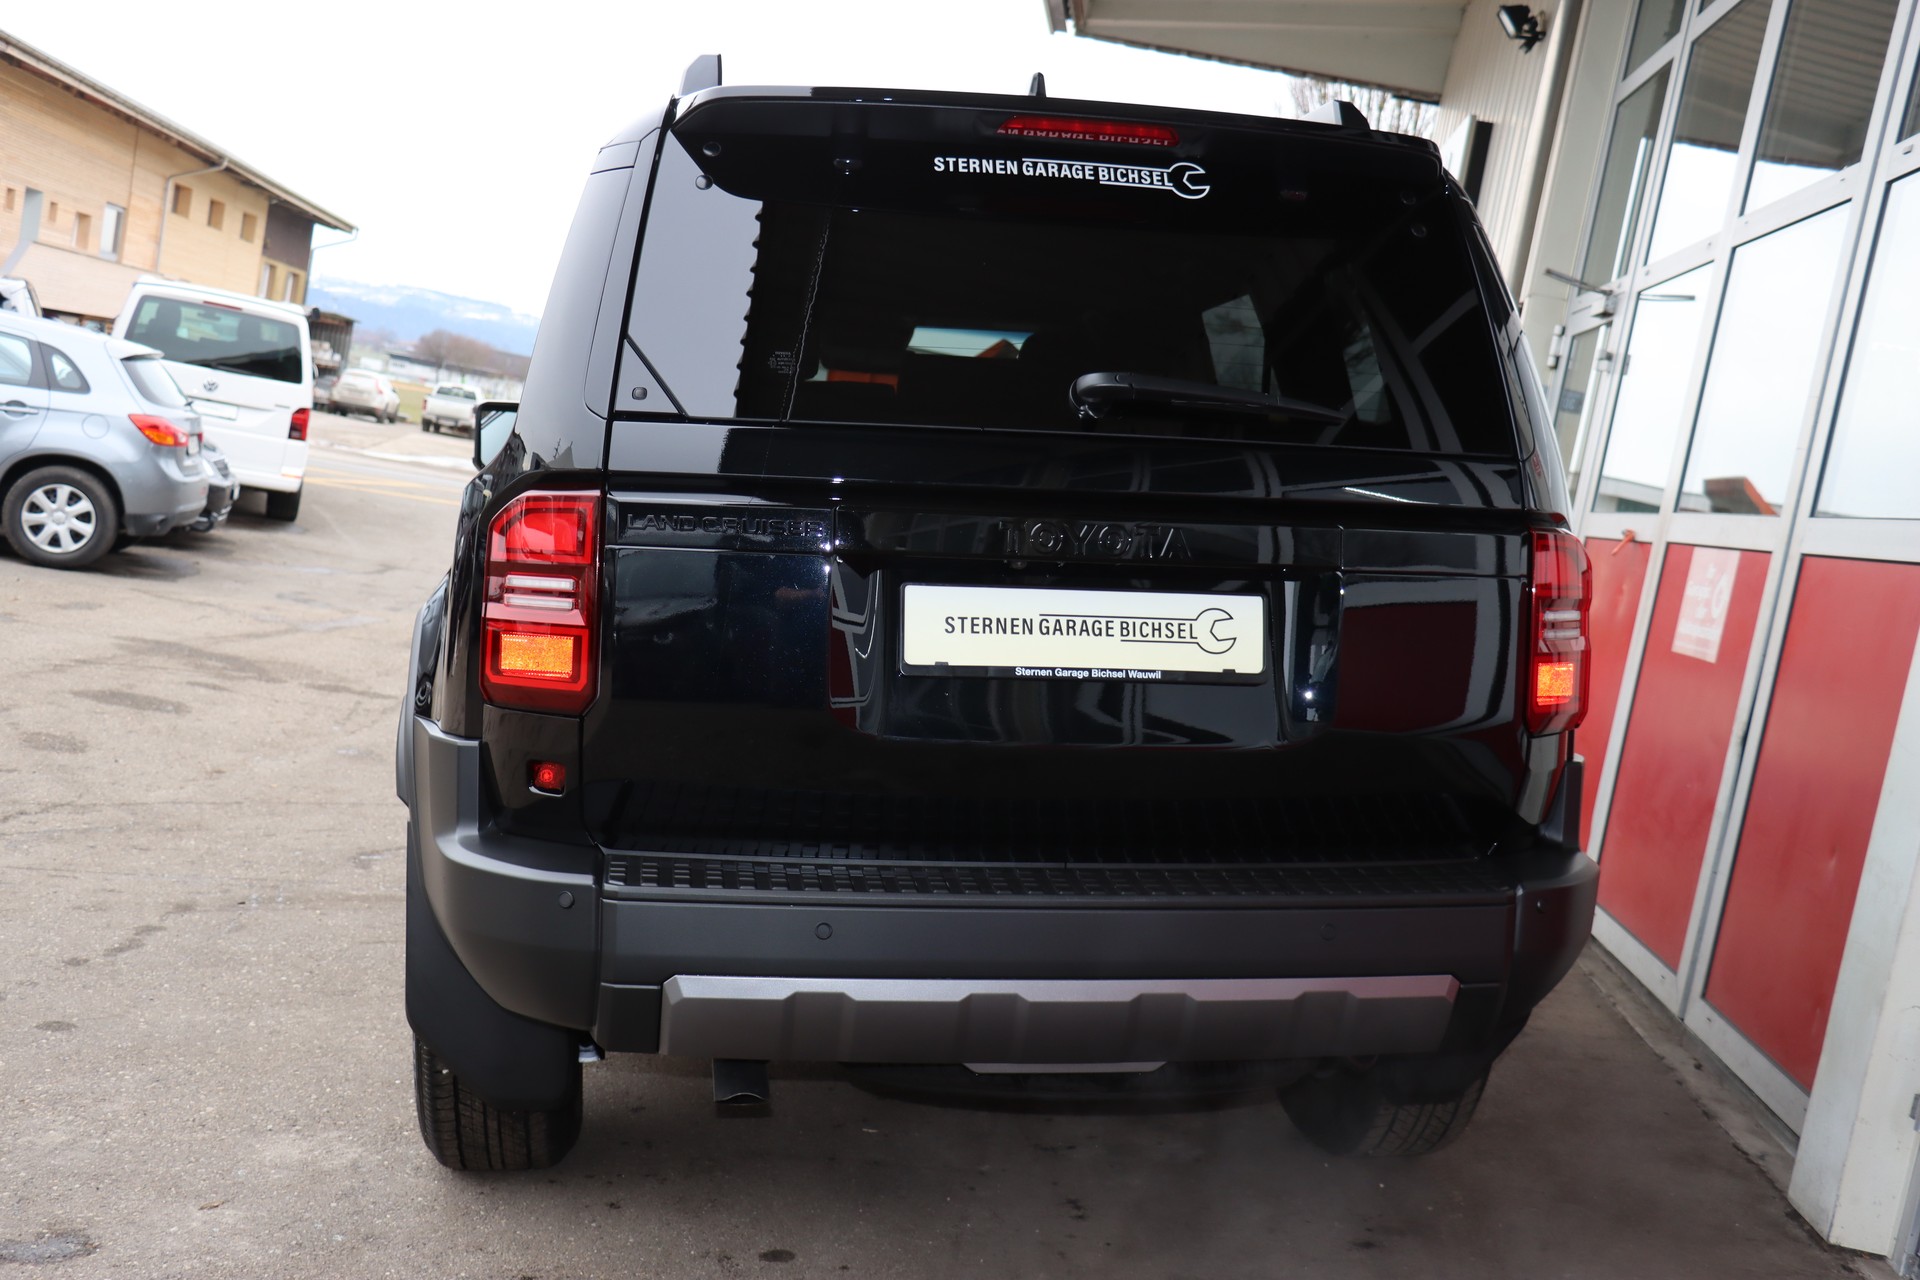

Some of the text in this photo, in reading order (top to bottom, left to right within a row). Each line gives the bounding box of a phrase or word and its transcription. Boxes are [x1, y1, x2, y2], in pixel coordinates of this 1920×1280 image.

[933, 156, 1174, 187] STERNEN GARAGE BICHSEL
[627, 513, 824, 538] LAND CRUISER
[999, 520, 1193, 560] TOYOTA
[944, 615, 1198, 640] STERNEN GARAGE BICHSEL
[1015, 666, 1161, 680] Sternen Garage Bichsel Wauwil
